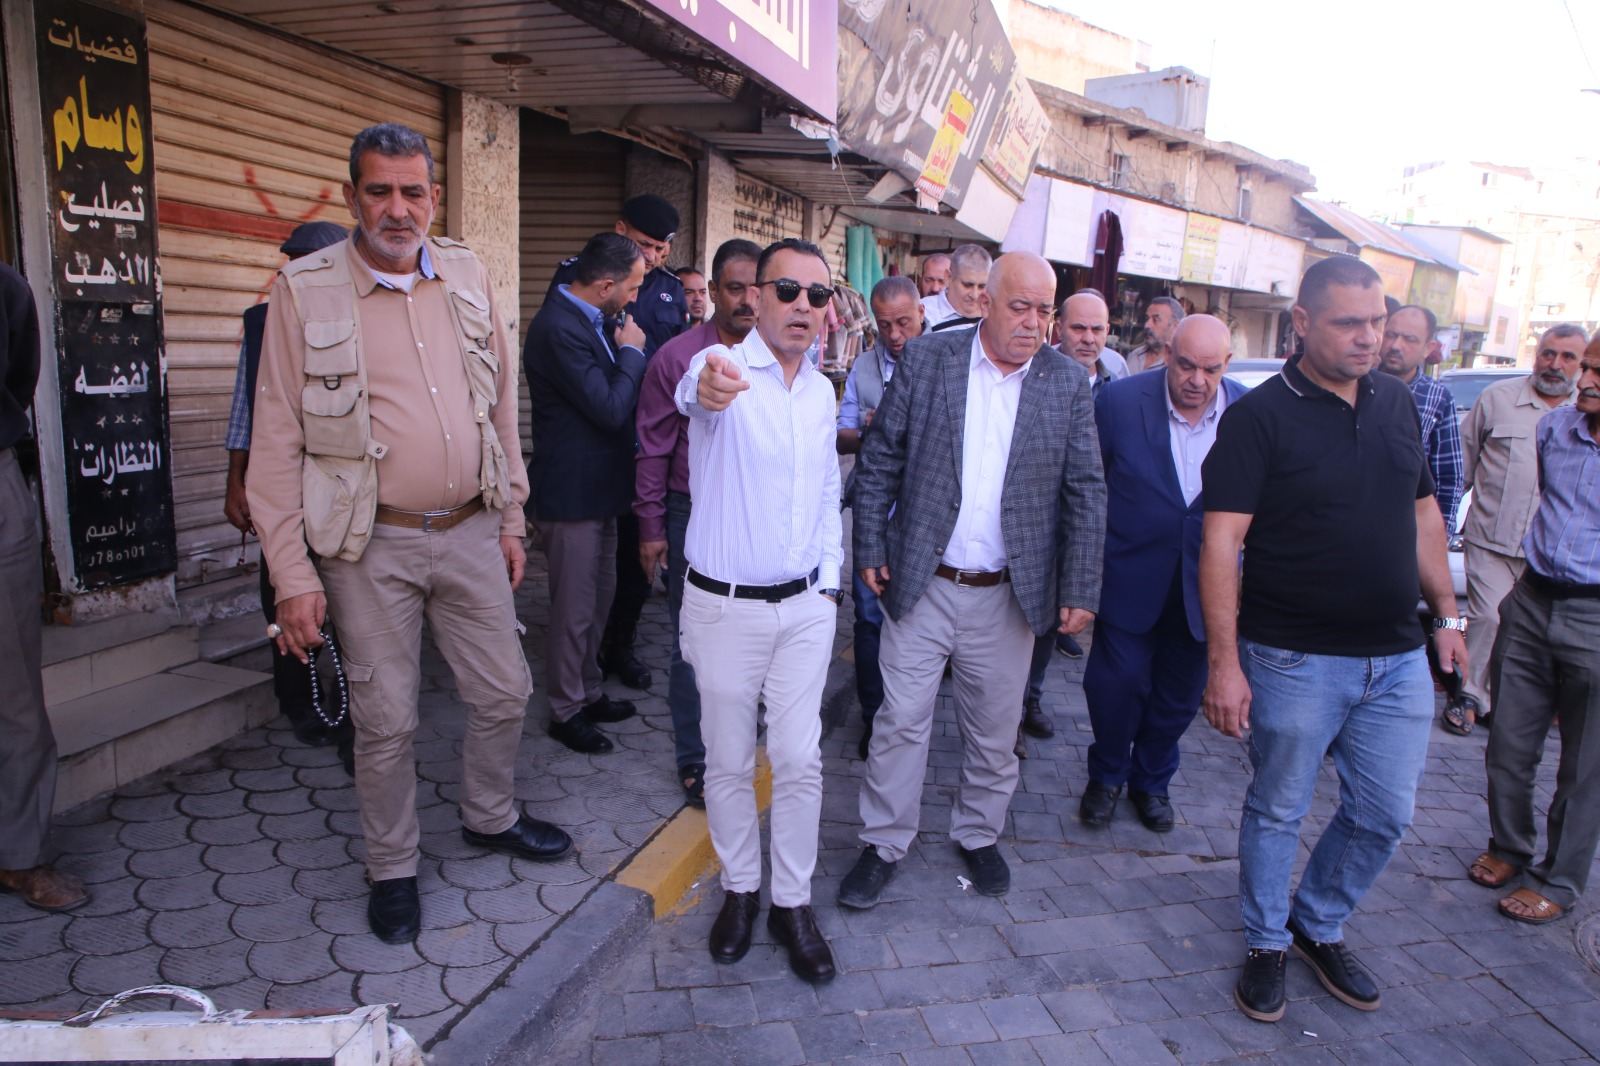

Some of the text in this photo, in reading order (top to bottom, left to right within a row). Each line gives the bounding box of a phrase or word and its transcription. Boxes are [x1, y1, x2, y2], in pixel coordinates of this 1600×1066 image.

[47, 17, 138, 65] فضيات
[53, 74, 145, 176] وسام
[59, 180, 145, 232] تصليح
[80, 439, 162, 485] النظارات
